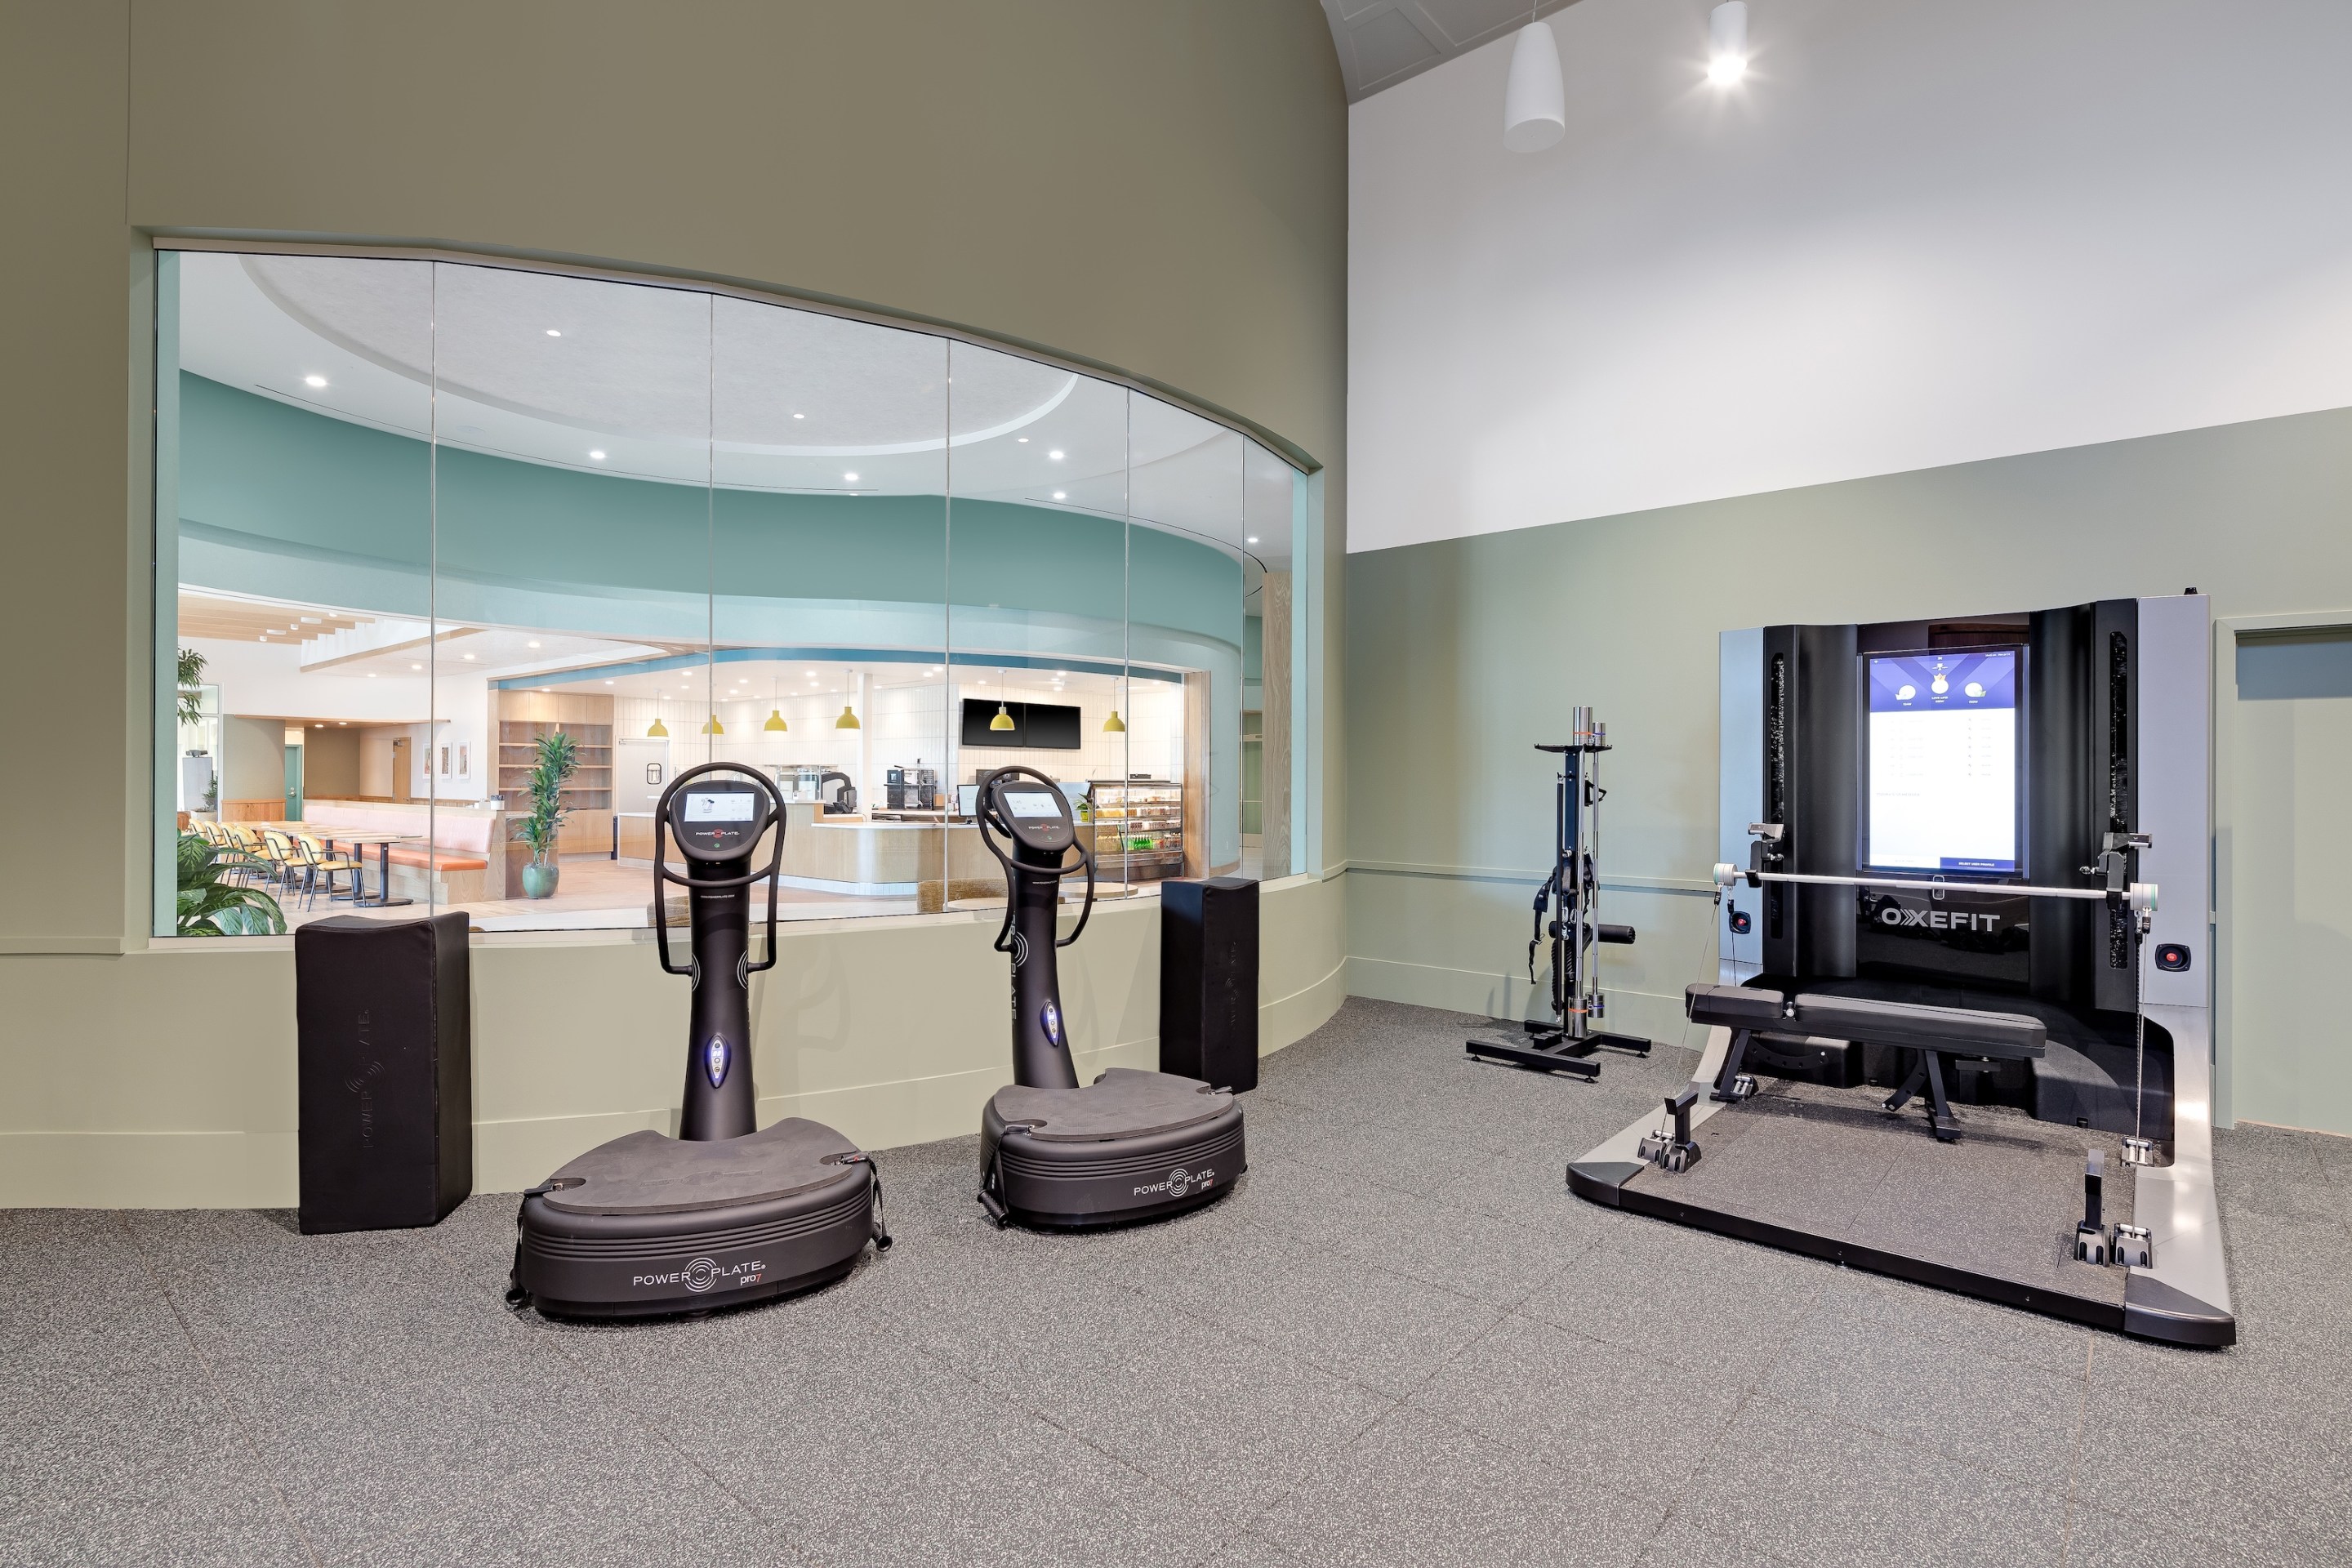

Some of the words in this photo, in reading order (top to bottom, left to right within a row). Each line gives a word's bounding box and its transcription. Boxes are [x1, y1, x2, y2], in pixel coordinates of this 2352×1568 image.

[1881, 907, 2001, 932] OXEFIT
[1134, 1182, 1173, 1196] POWER
[1184, 1169, 1214, 1184] PLATE
[1200, 1178, 1214, 1191] pro7
[633, 1271, 691, 1286] POWER
[710, 1260, 762, 1277] PLATE
[740, 1272, 762, 1286] pro7
